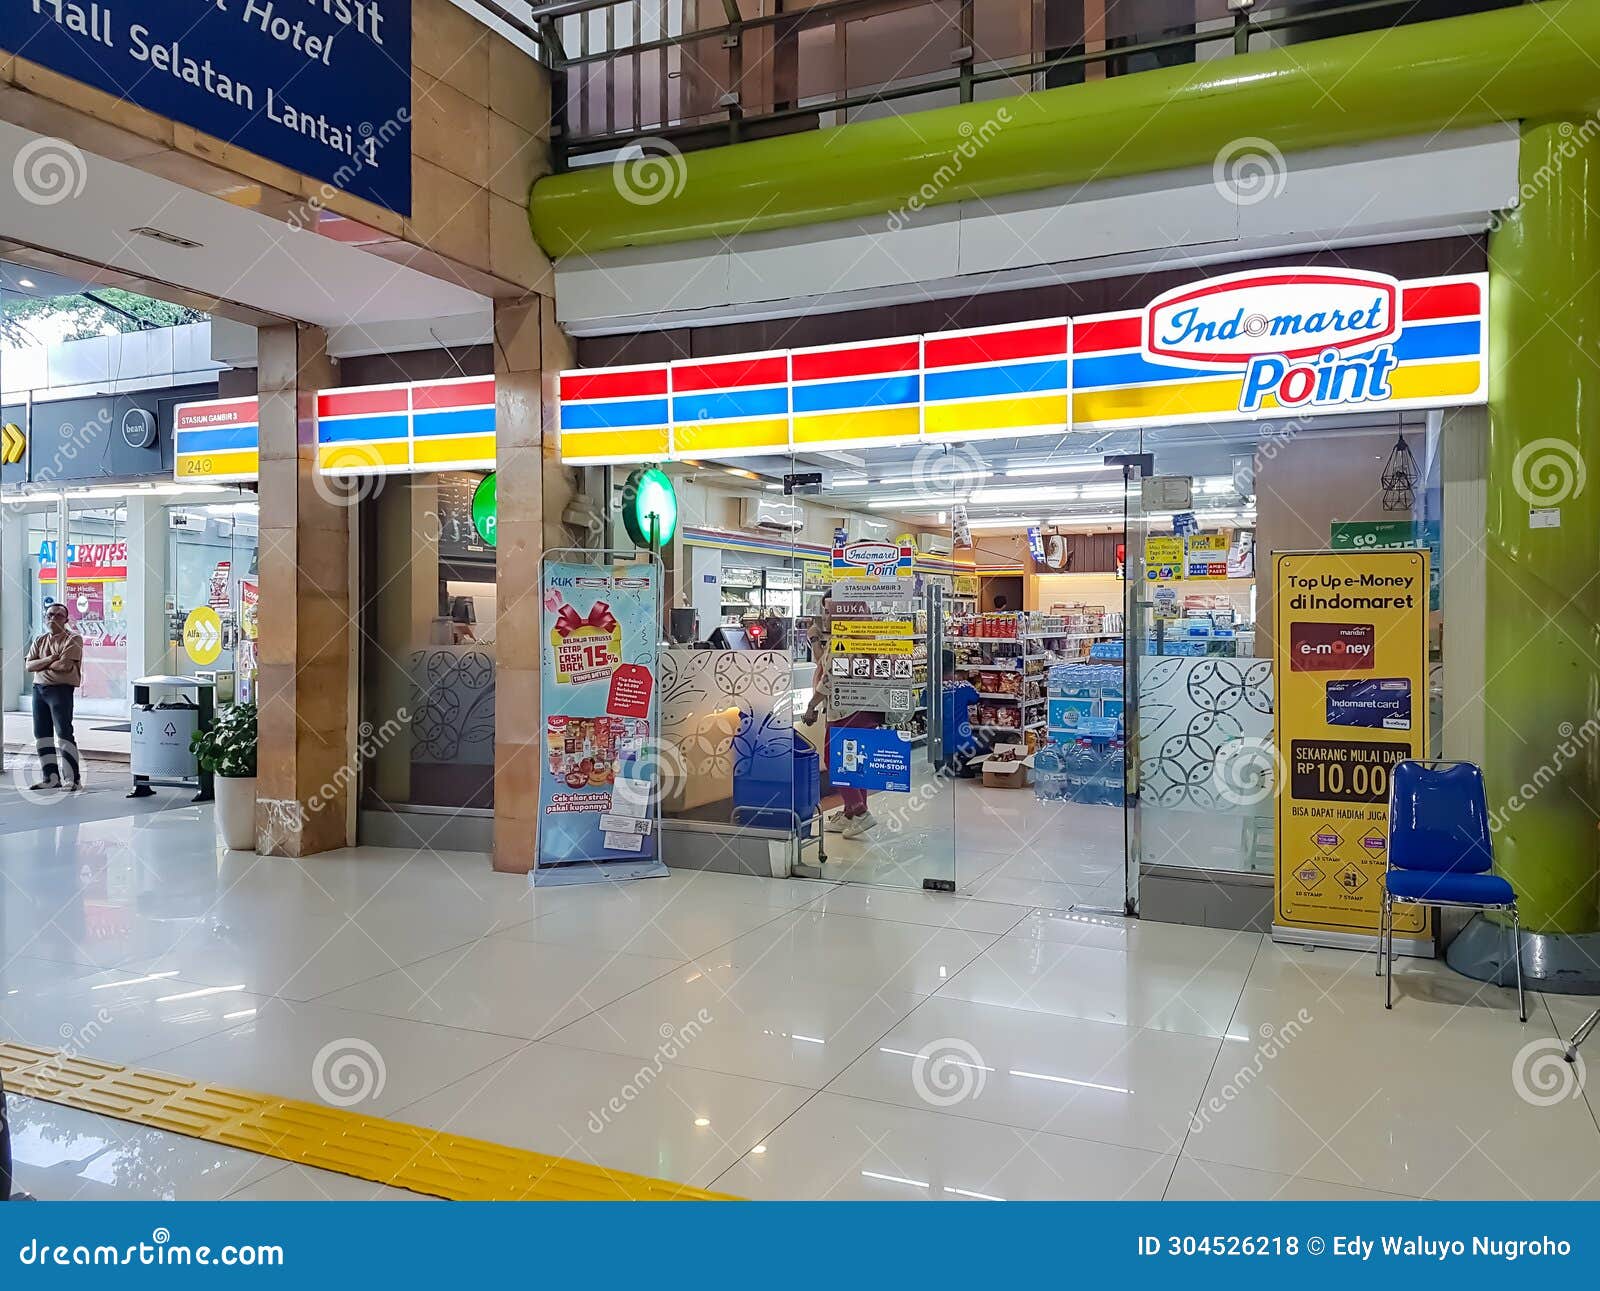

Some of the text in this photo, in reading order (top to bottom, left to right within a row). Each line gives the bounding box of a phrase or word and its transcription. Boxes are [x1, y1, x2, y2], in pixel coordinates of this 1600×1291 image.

[242, 0, 334, 65] Hotel
[33, 0, 380, 167] Hall Selatan Lantai 1
[1161, 297, 1382, 345] Indomaret
[1241, 345, 1397, 410] Point
[209, 413, 231, 422] GAMBIR
[187, 460, 201, 474] 24
[1353, 533, 1376, 546] GO
[848, 549, 896, 560] Indomaret
[866, 564, 898, 576] Point
[1288, 574, 1414, 590] Top Up e-Money
[1290, 593, 1413, 609] di Indomaret
[836, 605, 864, 613] BUKA
[1301, 641, 1370, 656] e-money
[559, 654, 583, 663] CASH
[583, 645, 618, 667] 15%
[560, 663, 584, 672] BACK
[1332, 700, 1399, 709] Indomaret card
[1296, 748, 1347, 761] SEKARANG
[1351, 750, 1380, 763] MULAI
[870, 762, 907, 771] NON-STOP!
[1297, 763, 1387, 796] RP 10.00
[552, 794, 567, 802] Cek
[570, 793, 586, 801] ekor
[547, 804, 568, 814] pakai
[1292, 807, 1387, 821] BISA DAPAT HADIAH JUGA
